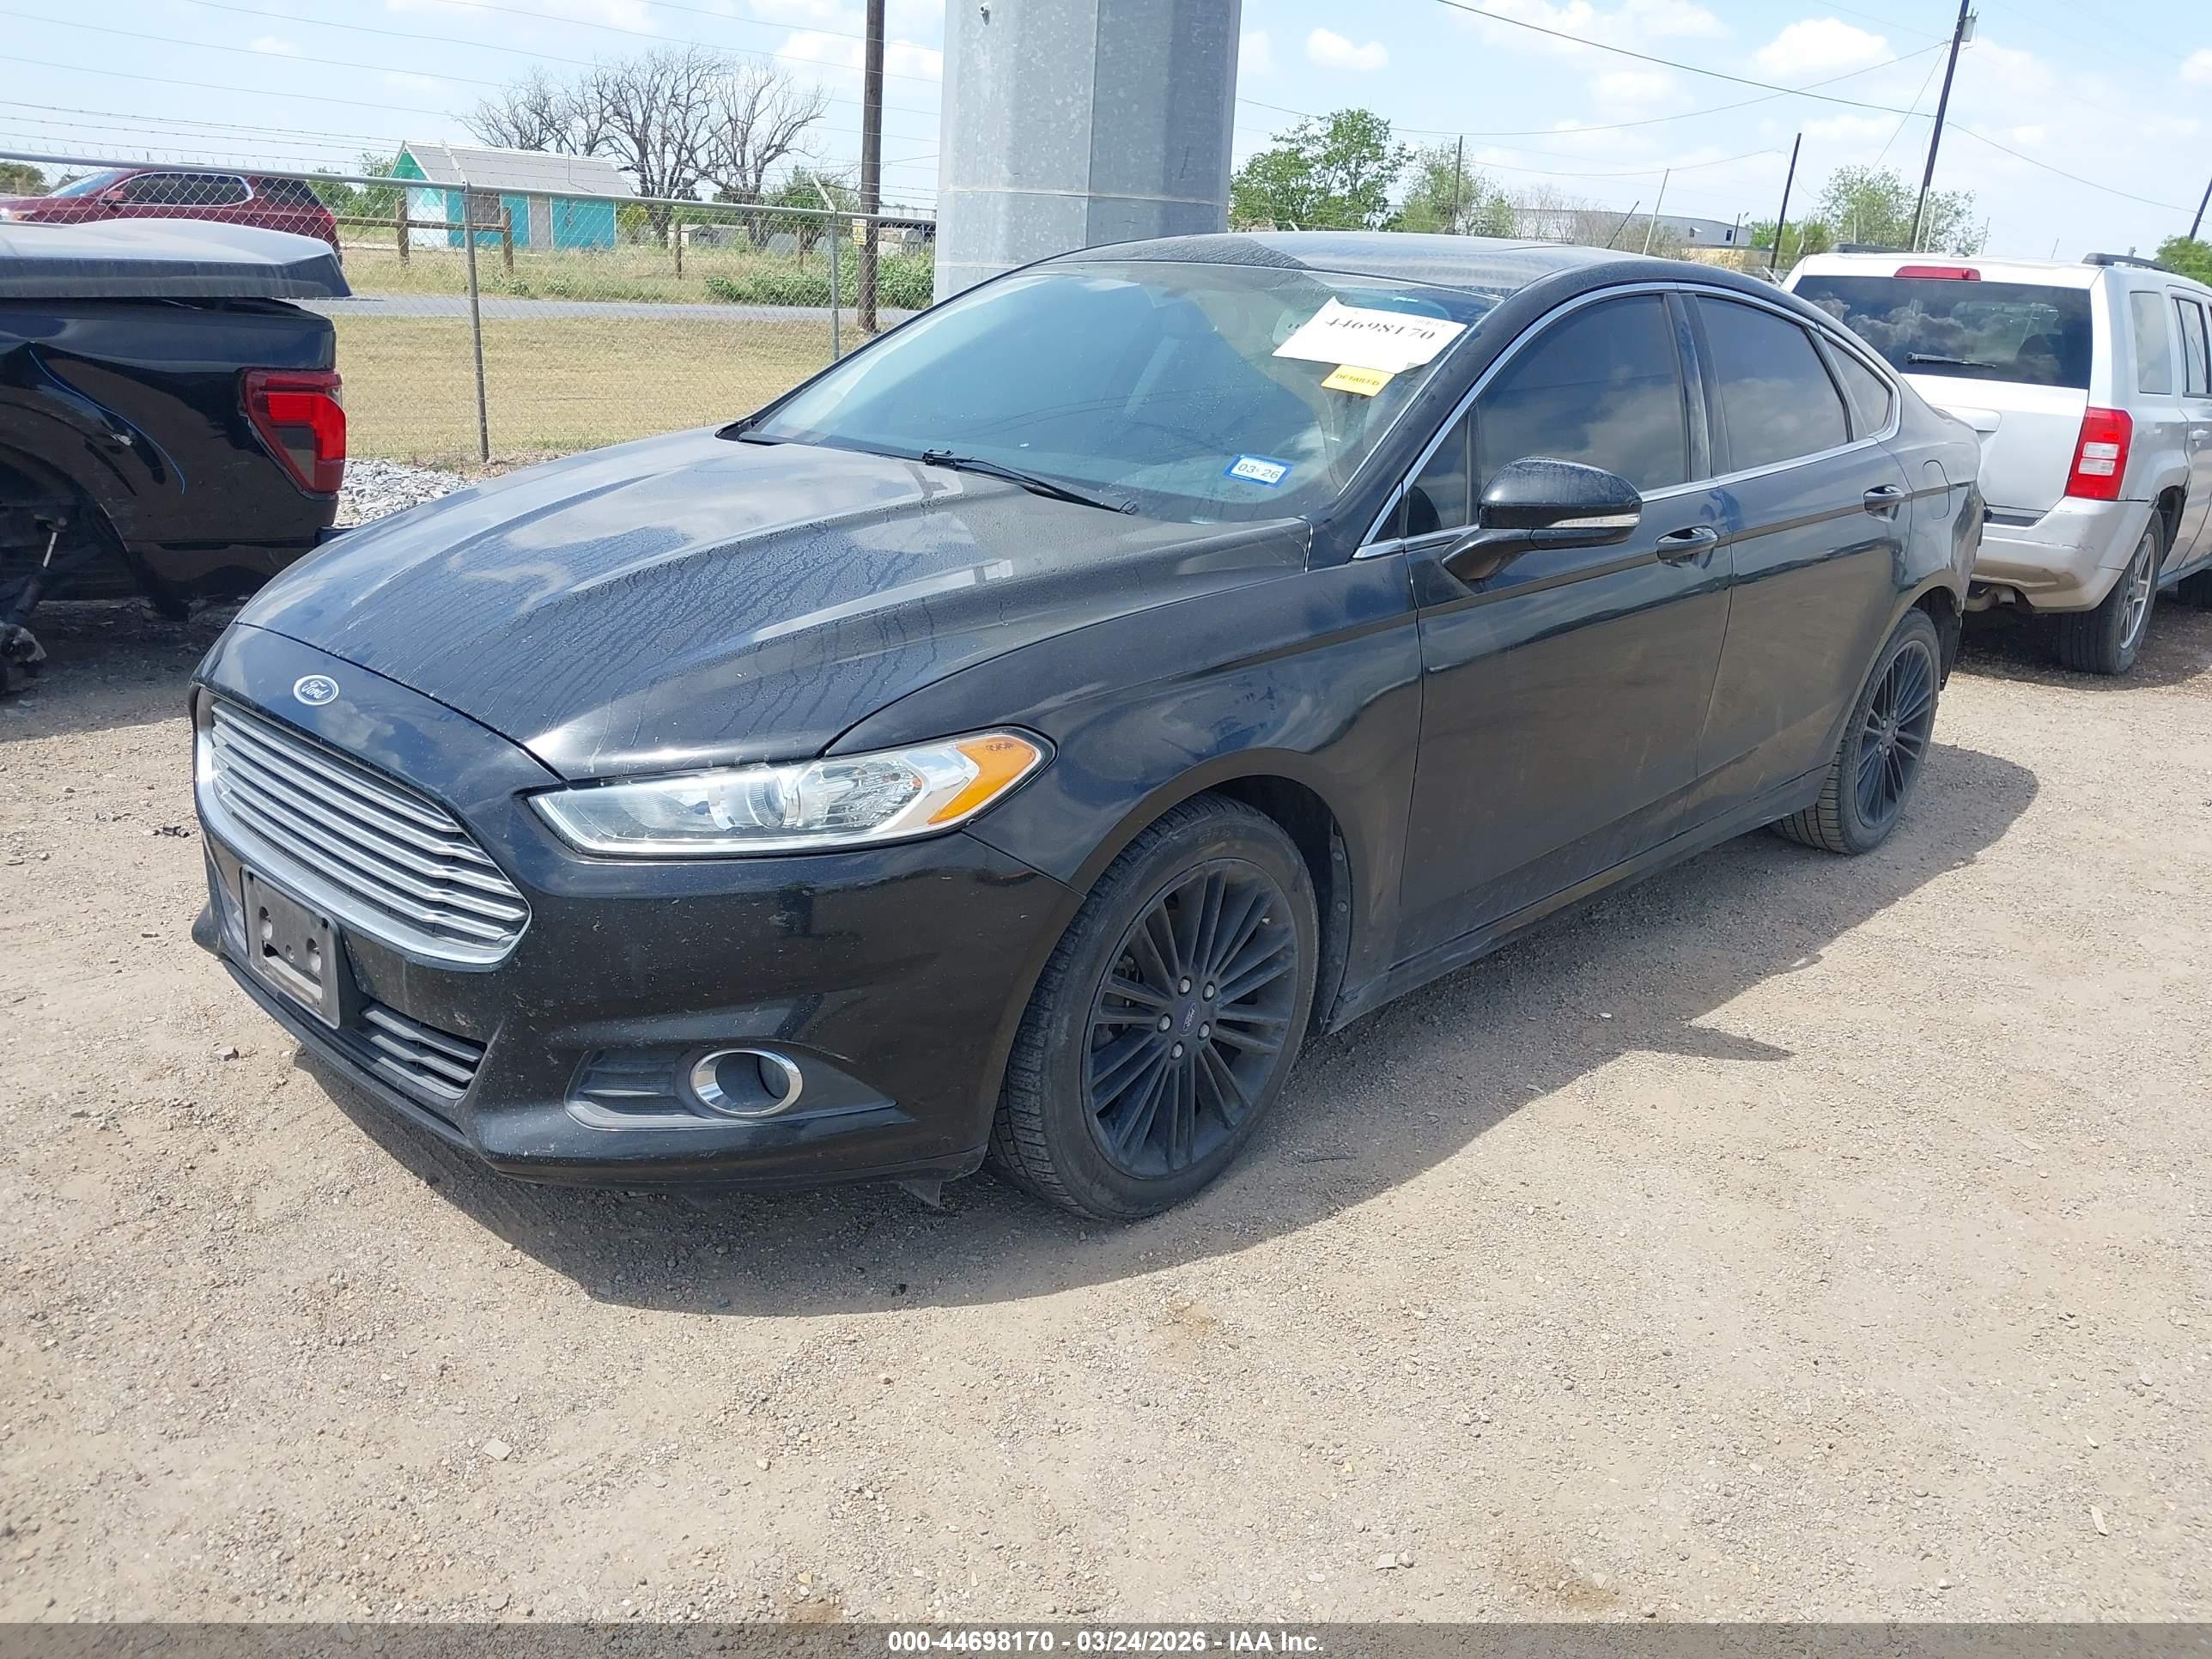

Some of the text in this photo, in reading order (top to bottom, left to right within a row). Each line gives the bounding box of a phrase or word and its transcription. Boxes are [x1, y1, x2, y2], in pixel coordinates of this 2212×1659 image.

[1325, 317, 1437, 340] 44698170
[1238, 463, 1280, 479] 03 26
[301, 679, 330, 700] Ford
